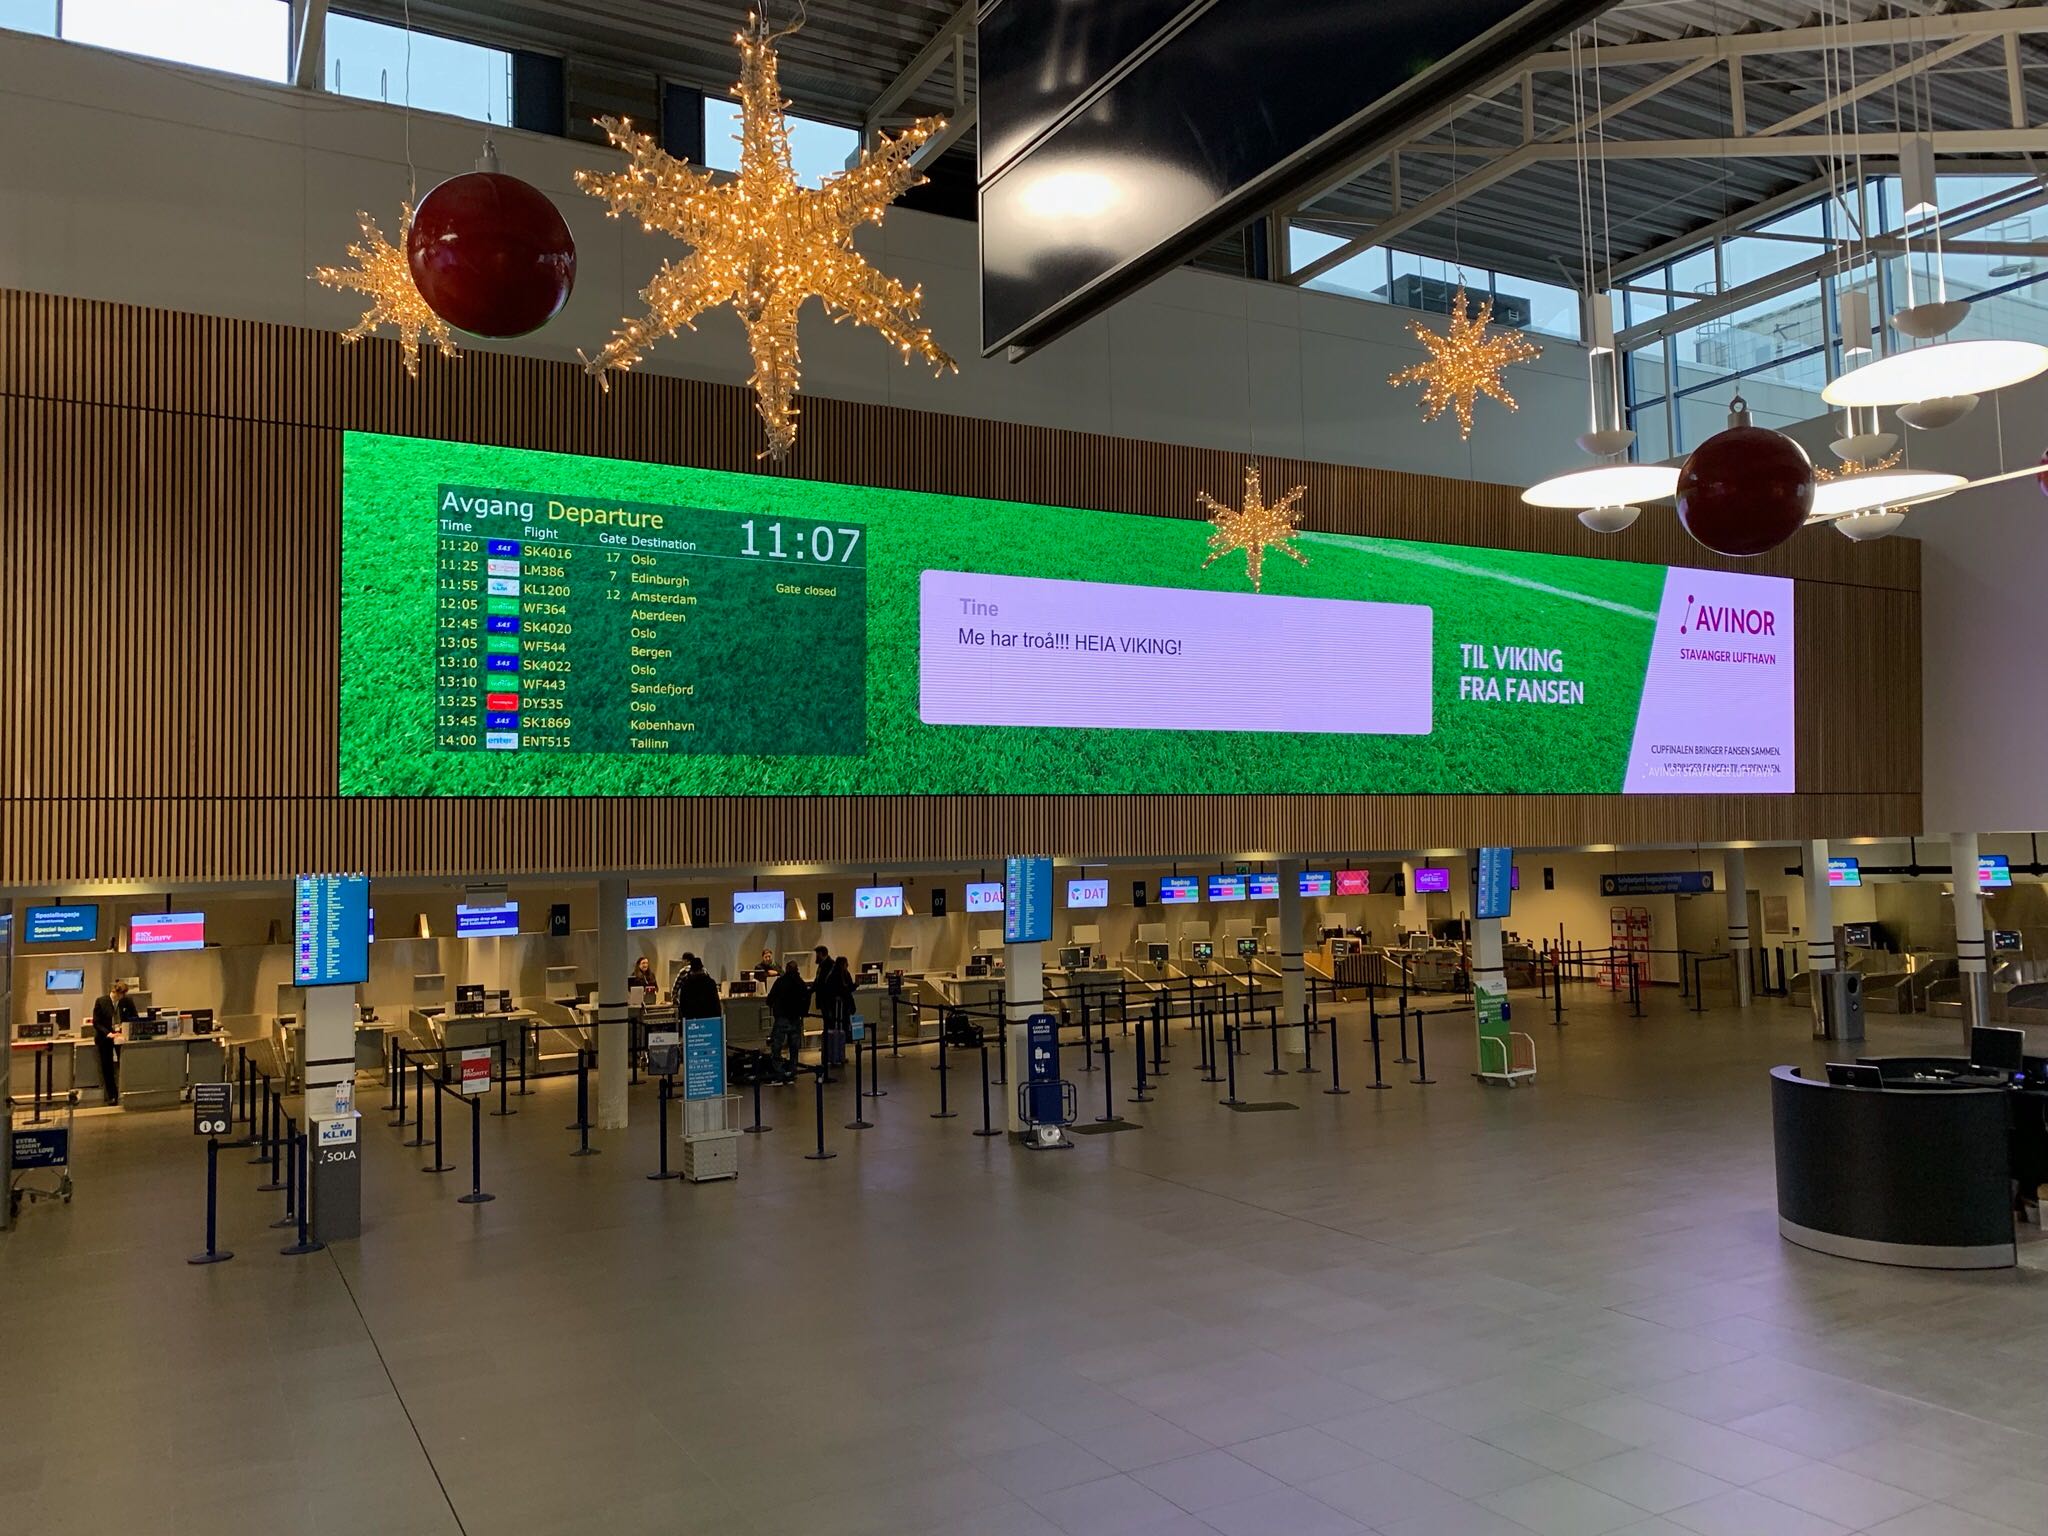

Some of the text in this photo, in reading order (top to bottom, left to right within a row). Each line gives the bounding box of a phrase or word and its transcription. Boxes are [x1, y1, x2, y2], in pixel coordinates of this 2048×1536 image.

[442, 491, 664, 529] Avgang Departure
[440, 519, 697, 550] Time Flight Gate Destination
[741, 519, 860, 563] 11:07
[440, 540, 478, 552] 11:20
[524, 546, 572, 559] SK4016
[606, 552, 620, 562] 17
[631, 554, 656, 566] Oslo
[440, 559, 478, 571] 11:25
[524, 565, 565, 577] LM386
[609, 571, 617, 581] 7
[631, 572, 690, 587] Edinburgh
[775, 583, 801, 595] Gate
[804, 585, 837, 597] closed
[440, 579, 478, 590] 11:55
[524, 584, 570, 596] KL1200
[606, 590, 620, 600] 12
[631, 591, 697, 605] Amsterdam
[440, 598, 478, 609] 12:05
[524, 603, 566, 614] WF364
[631, 609, 685, 622] Aberdeen
[960, 598, 999, 616] Tine
[440, 617, 478, 629] 12:45
[523, 622, 572, 635] SK4020
[631, 628, 656, 638] Oslo
[1696, 605, 1775, 636] AVINOR
[440, 637, 478, 648] 13:05
[523, 641, 566, 652] WF544
[631, 646, 672, 659] Bergen
[959, 628, 1182, 655] Me har troå!!! HEIA VIKING!
[1460, 644, 1563, 672] TIL VIKING
[1680, 648, 1776, 664] STAVANGER LUFTHAVN
[439, 657, 478, 668] 13:10
[523, 660, 571, 672] SK4022
[631, 665, 656, 675] Oslo
[439, 676, 477, 687] 13:10
[523, 679, 566, 691] WF443
[630, 682, 694, 696] Sandefjord
[1461, 675, 1584, 704] FRA FANSEN
[439, 696, 477, 707] 13:25
[523, 698, 563, 710] DY535
[630, 701, 656, 712] Oslo
[439, 715, 477, 727] 13:45
[522, 717, 571, 729] SK1869
[630, 720, 695, 731] København
[439, 735, 477, 746] 14:00
[522, 736, 570, 747] ENT515
[630, 738, 669, 749] Tallinn
[1651, 744, 1781, 756] CUPFINALEN BRINGER FANSEN SAMMEN.
[874, 896, 899, 908] DAT
[935, 898, 944, 906] 07
[984, 892, 1001, 903] DA
[1084, 888, 1106, 899] DAT
[1135, 889, 1144, 897] 09
[695, 908, 706, 916] 05
[820, 903, 831, 911] 06
[555, 915, 566, 925] 04
[323, 1130, 352, 1139] KLM
[327, 1150, 356, 1162] SOLA
